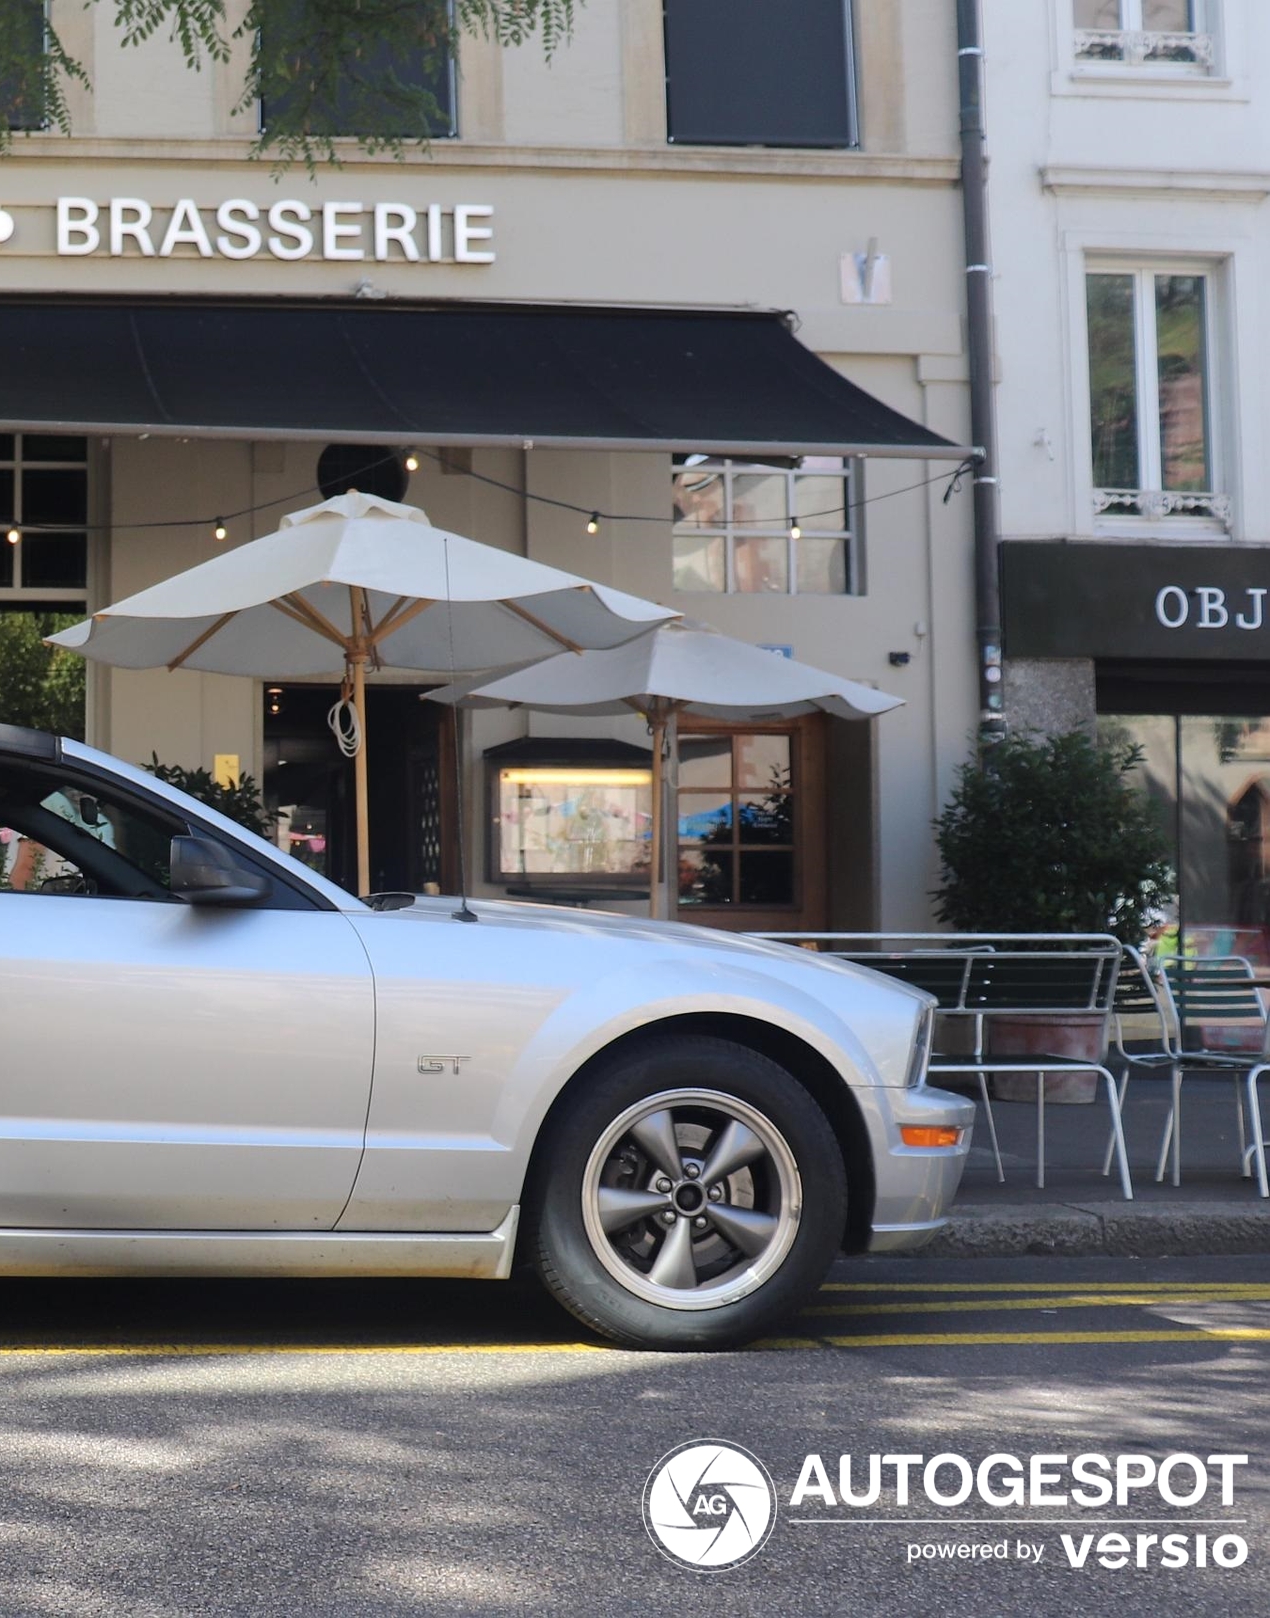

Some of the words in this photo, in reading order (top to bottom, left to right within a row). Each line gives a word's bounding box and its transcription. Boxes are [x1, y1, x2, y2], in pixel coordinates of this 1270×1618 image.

[56, 196, 496, 263] BRASSERIE
[1155, 585, 1268, 631] OBJ
[418, 1053, 472, 1075] GT
